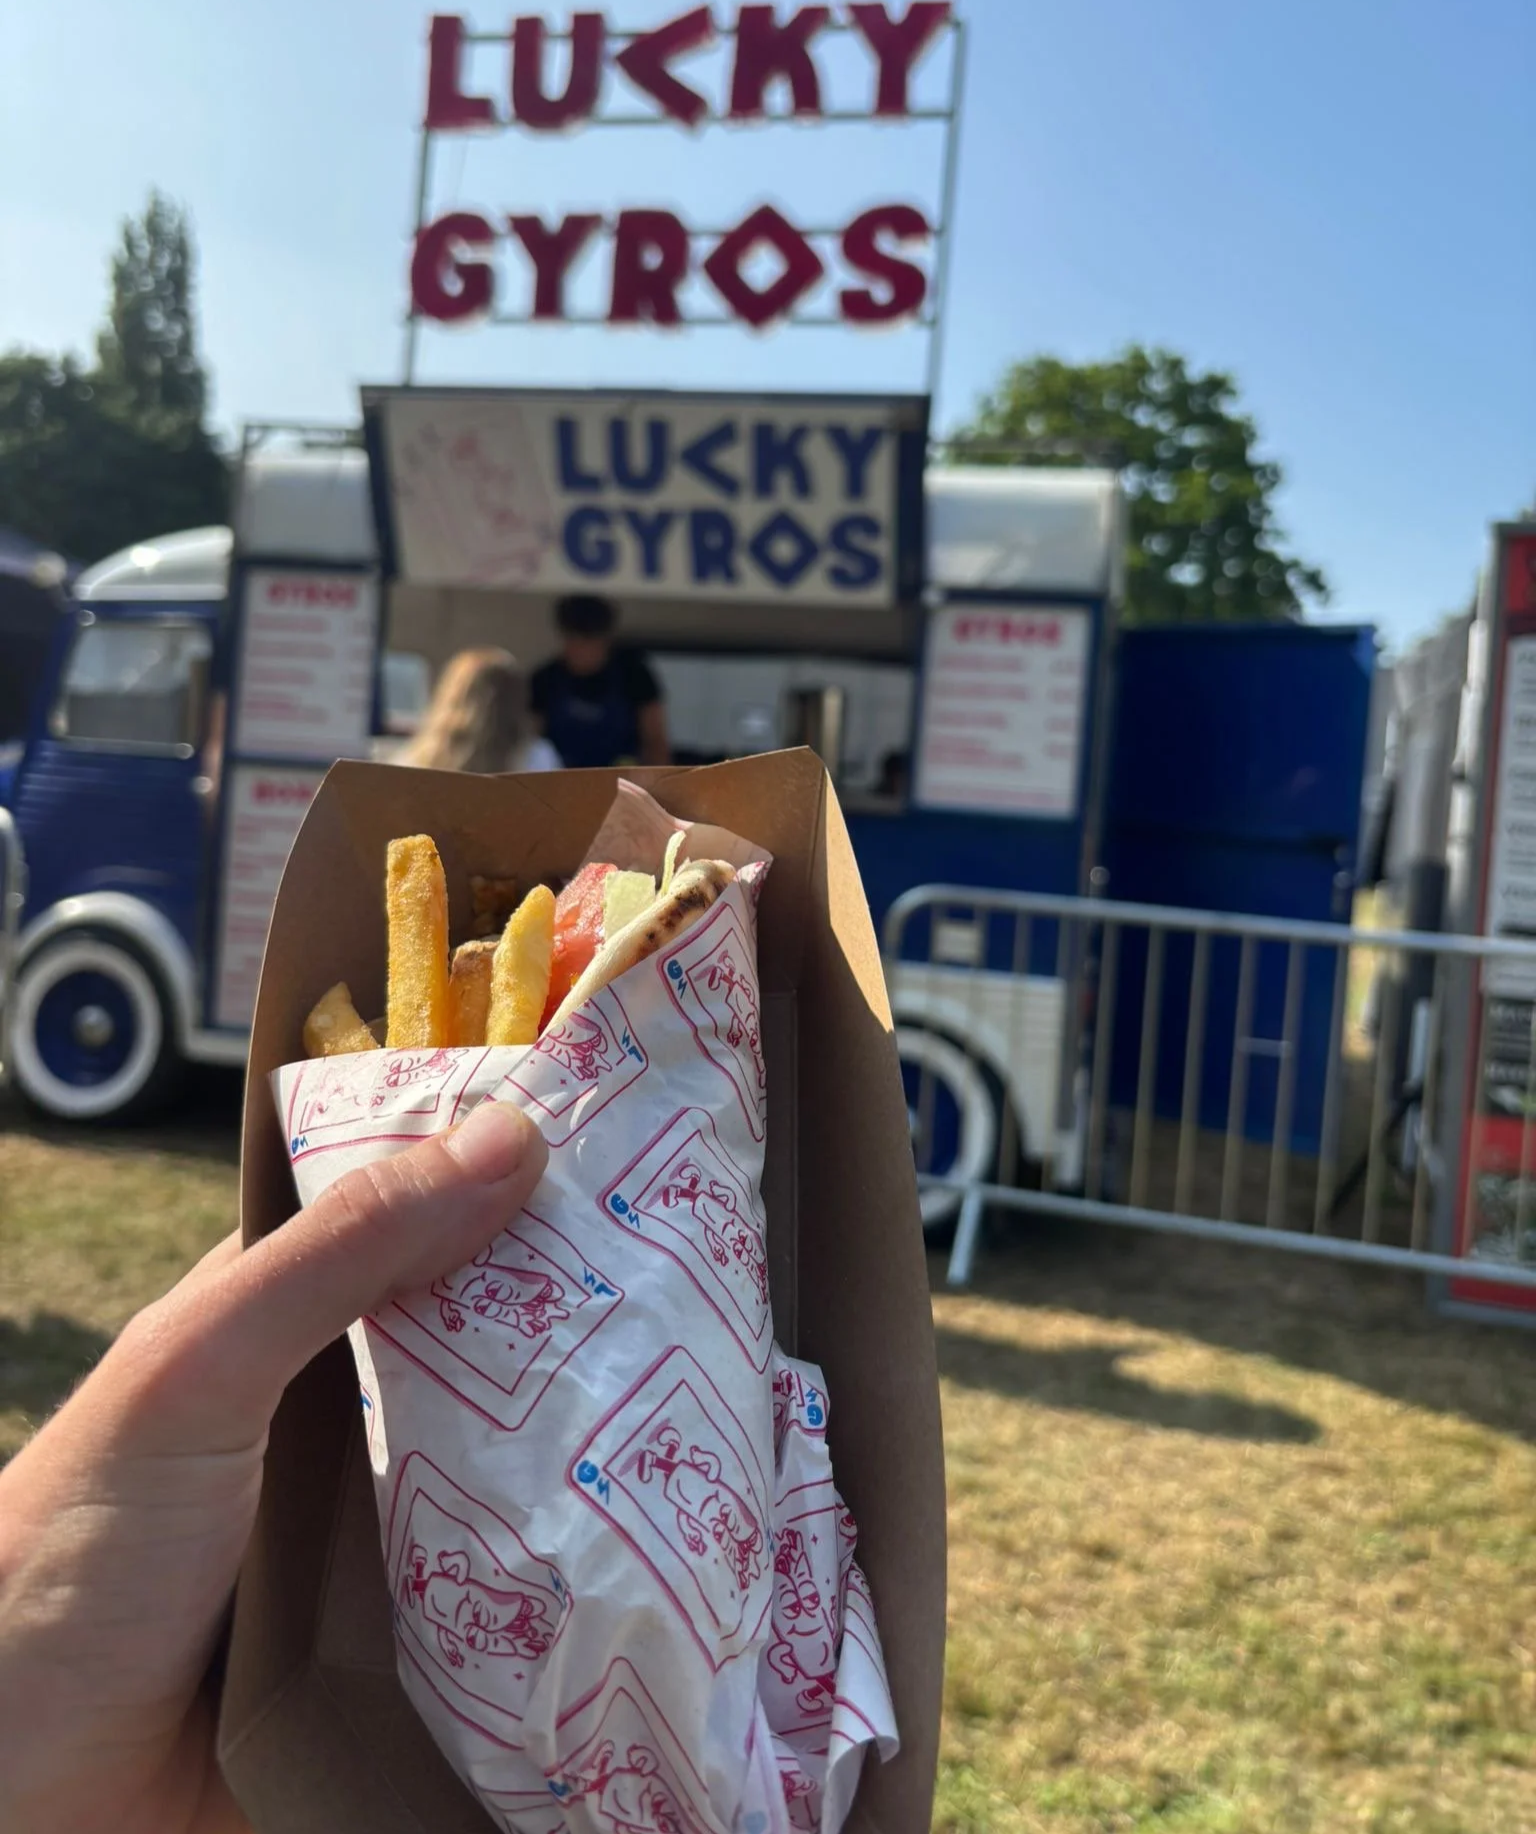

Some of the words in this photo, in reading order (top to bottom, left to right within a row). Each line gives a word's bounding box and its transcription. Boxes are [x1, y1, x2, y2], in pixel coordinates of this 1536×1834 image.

[424, 3, 950, 129] LUCKY
[411, 205, 929, 327] GYROS
[555, 418, 889, 499] LUCKY
[562, 505, 885, 591] GYROS
